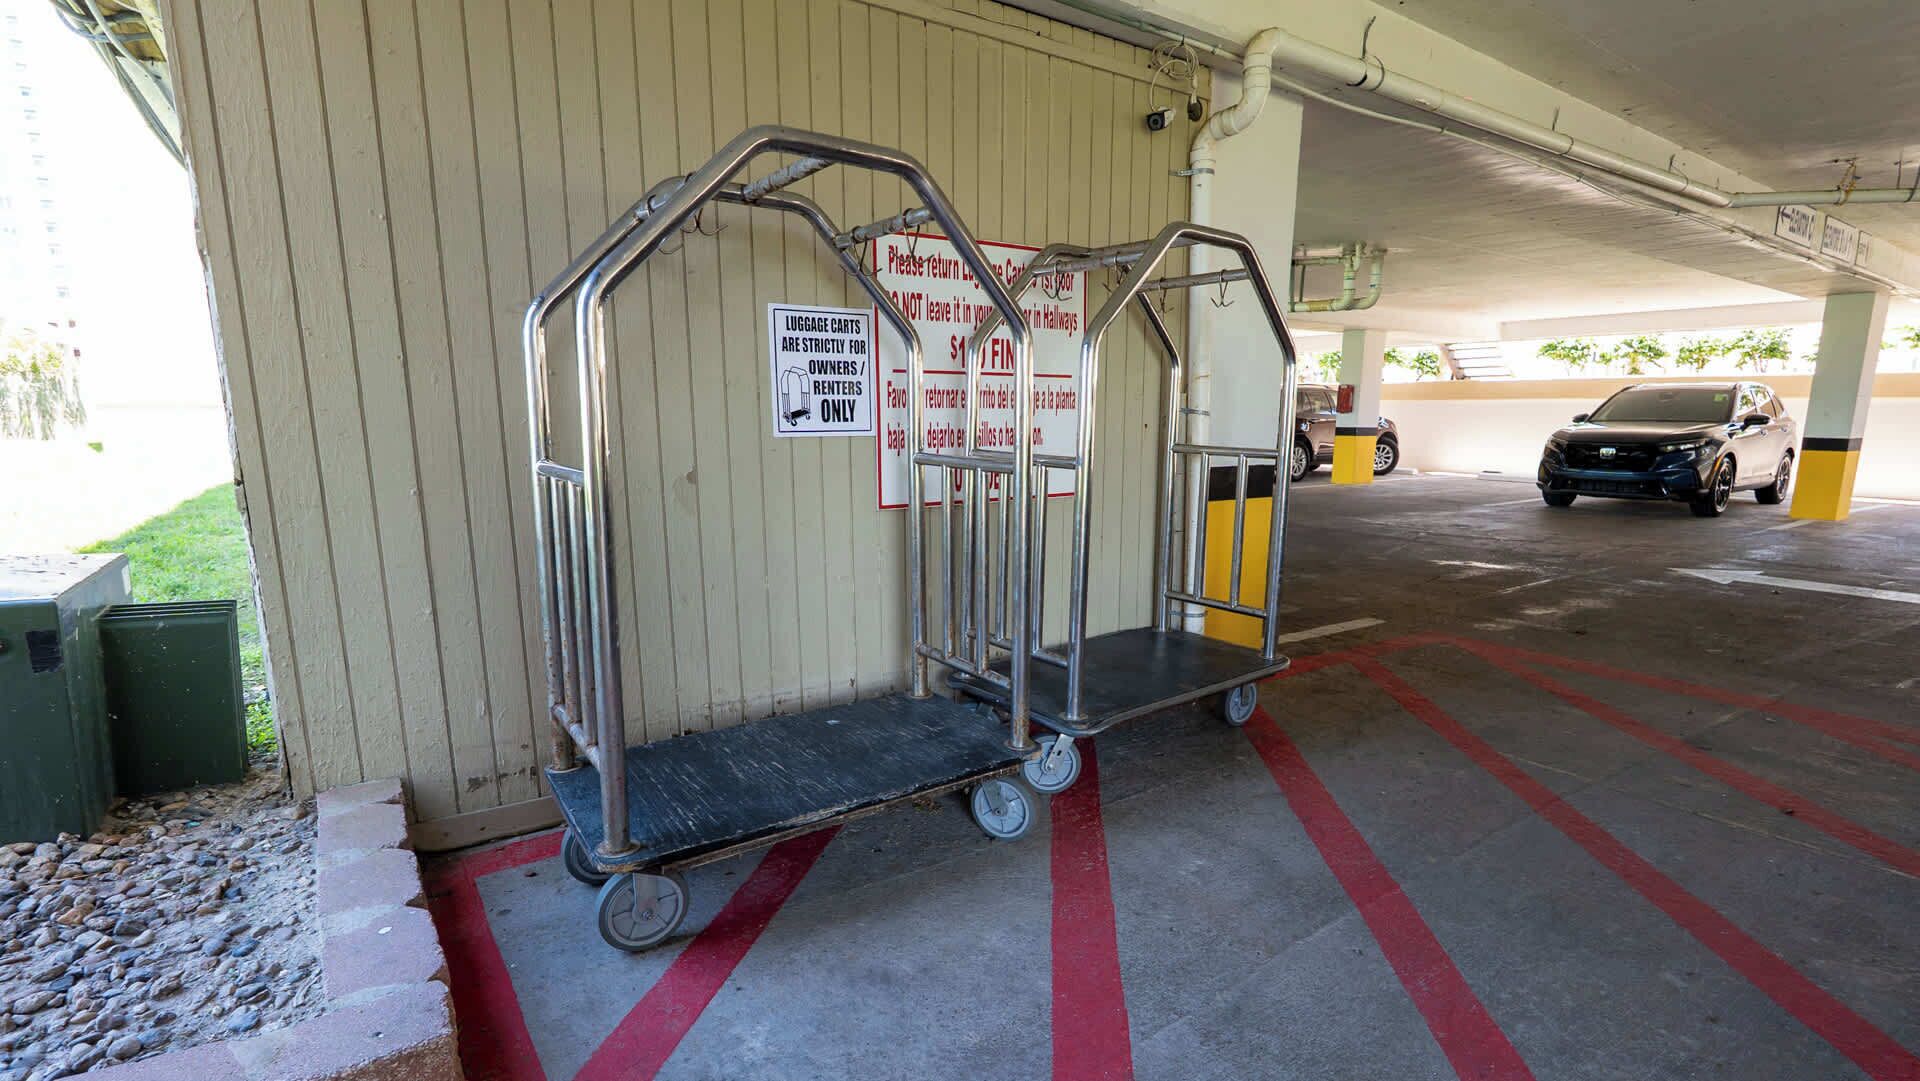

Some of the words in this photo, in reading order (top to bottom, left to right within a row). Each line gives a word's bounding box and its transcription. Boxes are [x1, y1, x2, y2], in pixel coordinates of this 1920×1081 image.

[888, 245, 924, 277] Please
[927, 252, 959, 280] return
[786, 315, 829, 333] LUGGAGE
[831, 318, 860, 334] CARTS
[902, 291, 922, 321] NOT
[926, 293, 951, 322] leave
[953, 296, 961, 323] it
[963, 297, 972, 324] in
[1033, 303, 1041, 328] in
[1043, 303, 1078, 338] Hallways
[782, 337, 800, 352] ARE
[802, 338, 845, 354] STRICTLY
[849, 340, 866, 355] FOR
[809, 360, 857, 376] OWNERS
[814, 380, 862, 396] RENTERS
[887, 380, 907, 409] Favo
[925, 384, 959, 409] retornar
[998, 383, 1009, 409] del
[1042, 390, 1046, 409] a
[1047, 384, 1054, 409] la
[1055, 384, 1076, 417] planta
[821, 399, 856, 423] ONLY
[887, 422, 905, 457] baja
[927, 421, 955, 455] dejarlo
[999, 426, 1004, 447] o
